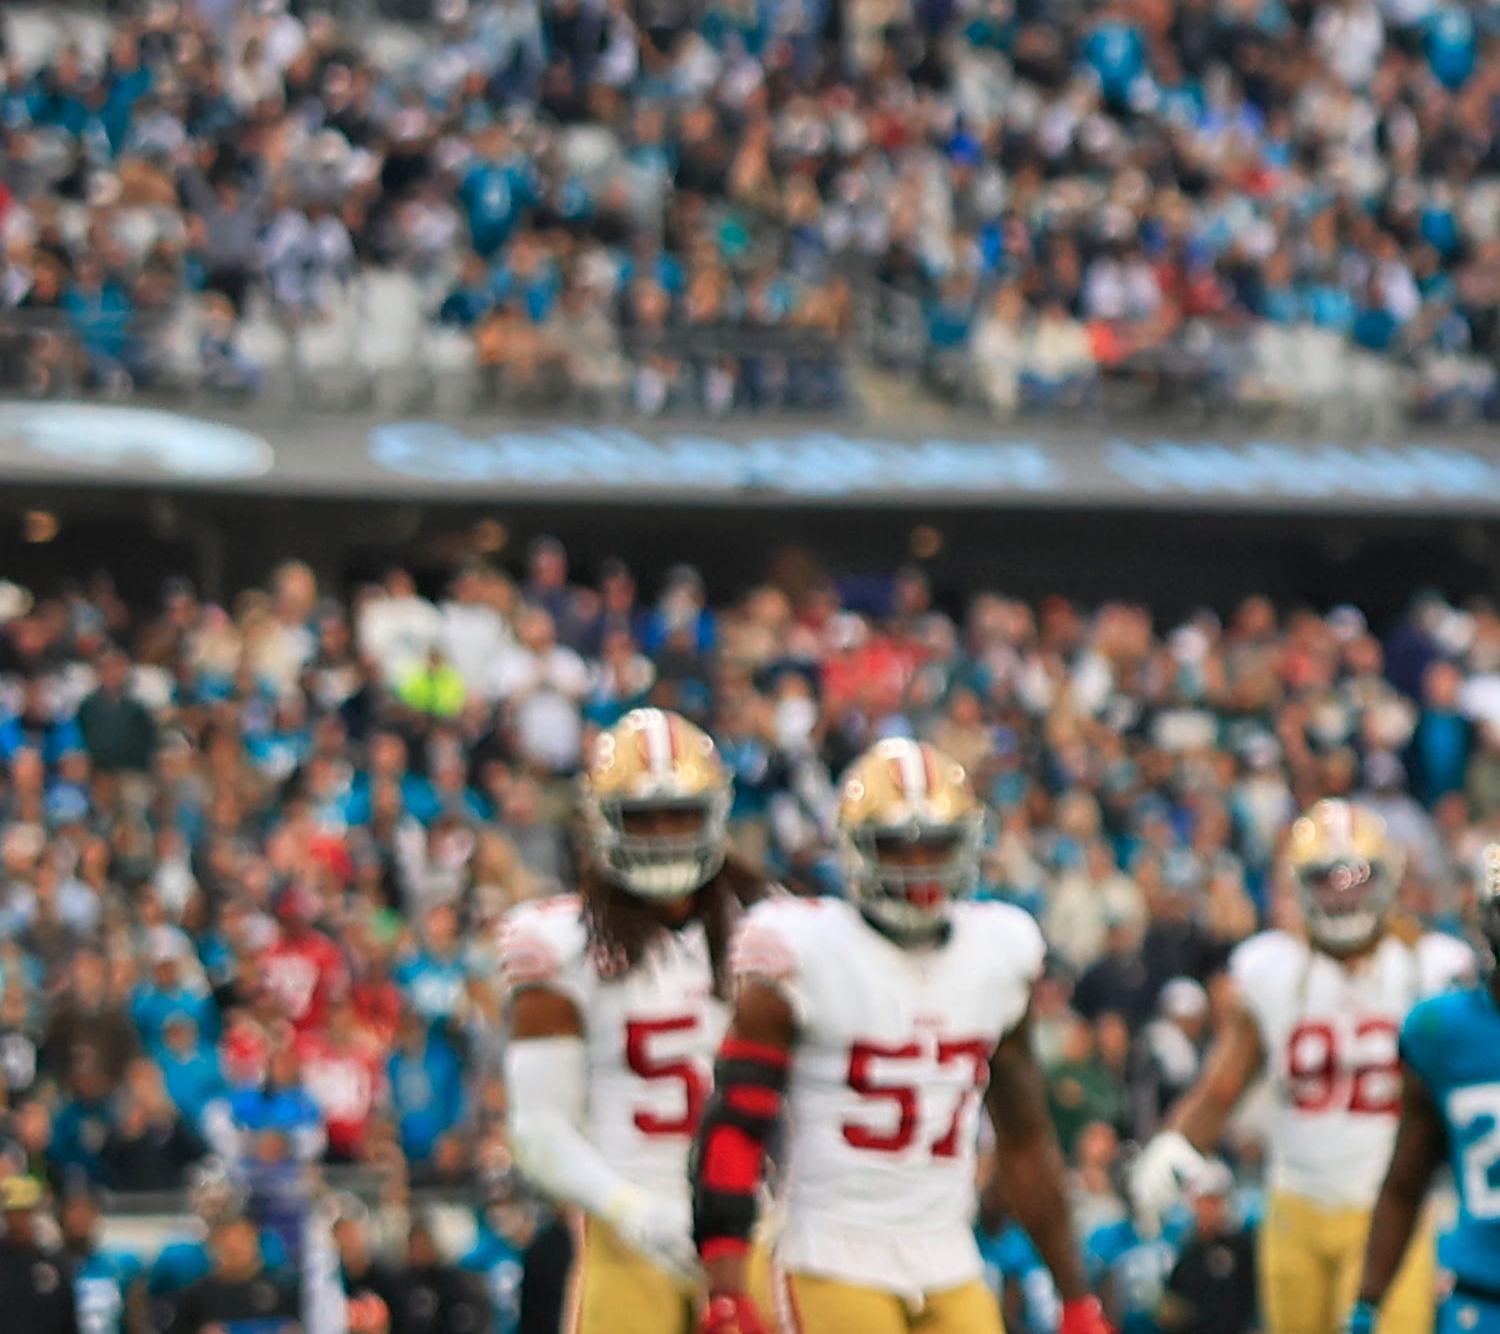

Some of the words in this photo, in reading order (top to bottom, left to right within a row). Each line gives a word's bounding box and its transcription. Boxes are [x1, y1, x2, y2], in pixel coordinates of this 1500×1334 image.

[625, 1016, 700, 1141] 5
[842, 1038, 992, 1159] 57
[1288, 1017, 1401, 1116] 92
